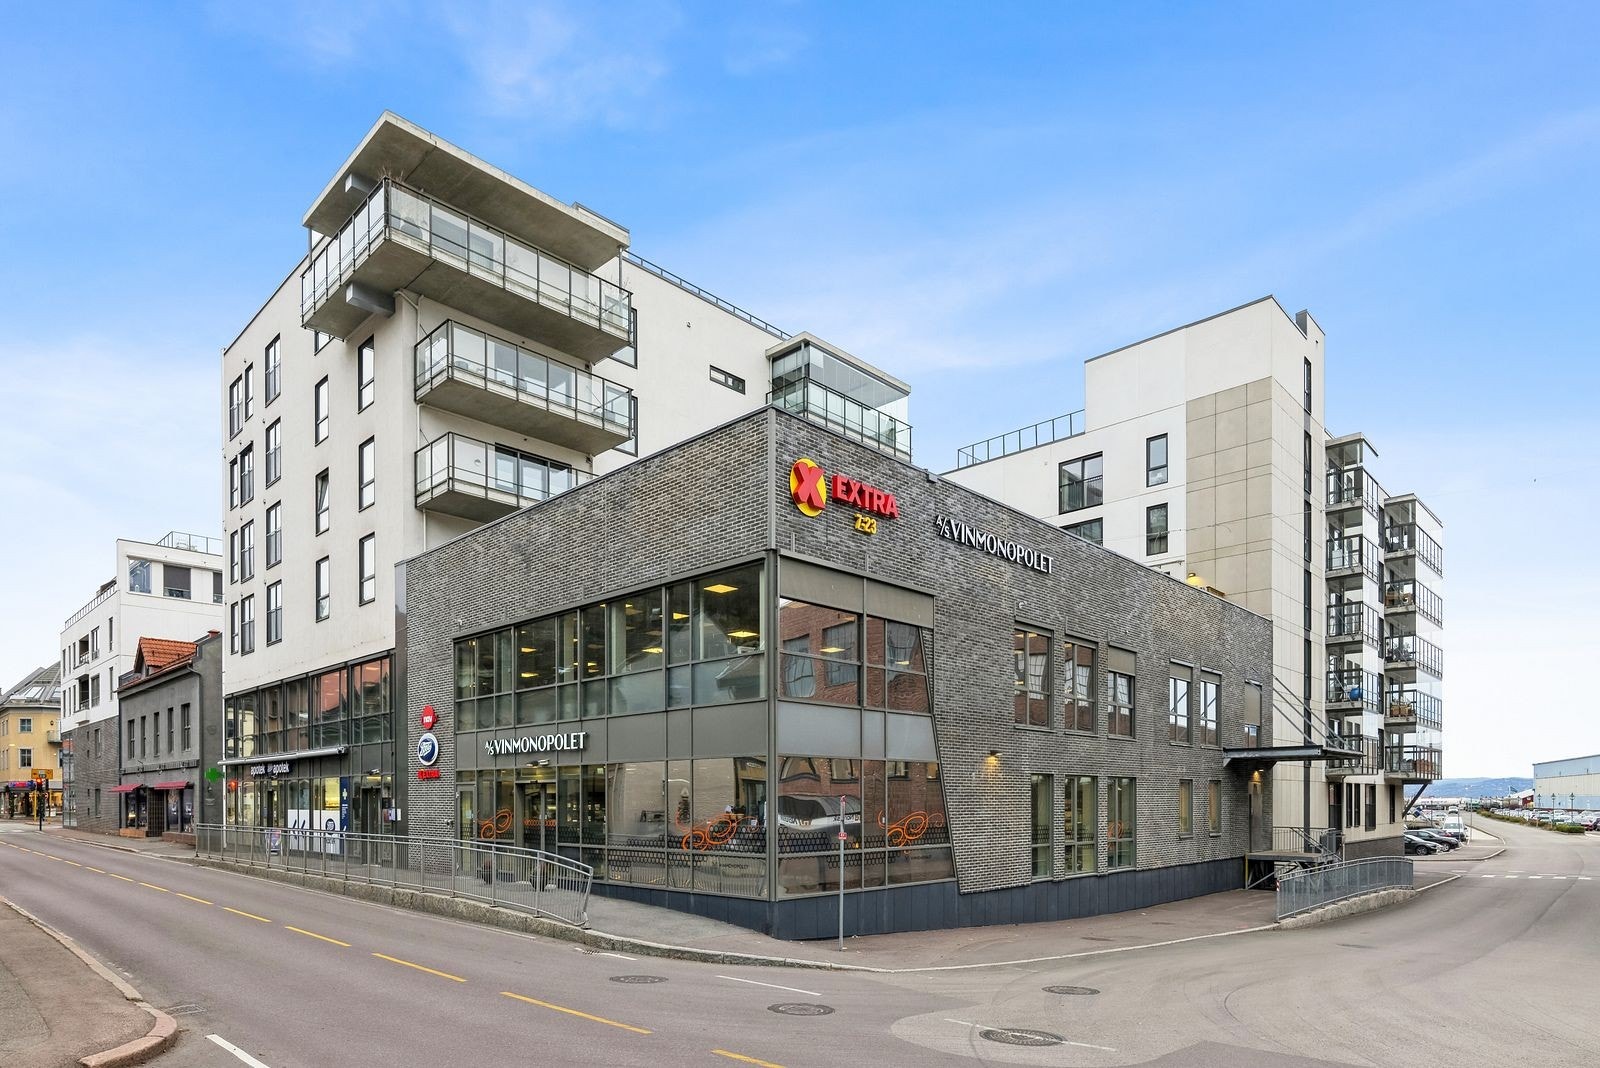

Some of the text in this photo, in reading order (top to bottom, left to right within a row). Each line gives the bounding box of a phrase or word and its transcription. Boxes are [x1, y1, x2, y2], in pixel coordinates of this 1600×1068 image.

[832, 474, 899, 519] EXTRA
[854, 513, 877, 534] 7-23
[949, 519, 1053, 573] VINMONOPOLET
[494, 732, 586, 755] VINMONOPOLET
[273, 761, 290, 776] apotek
